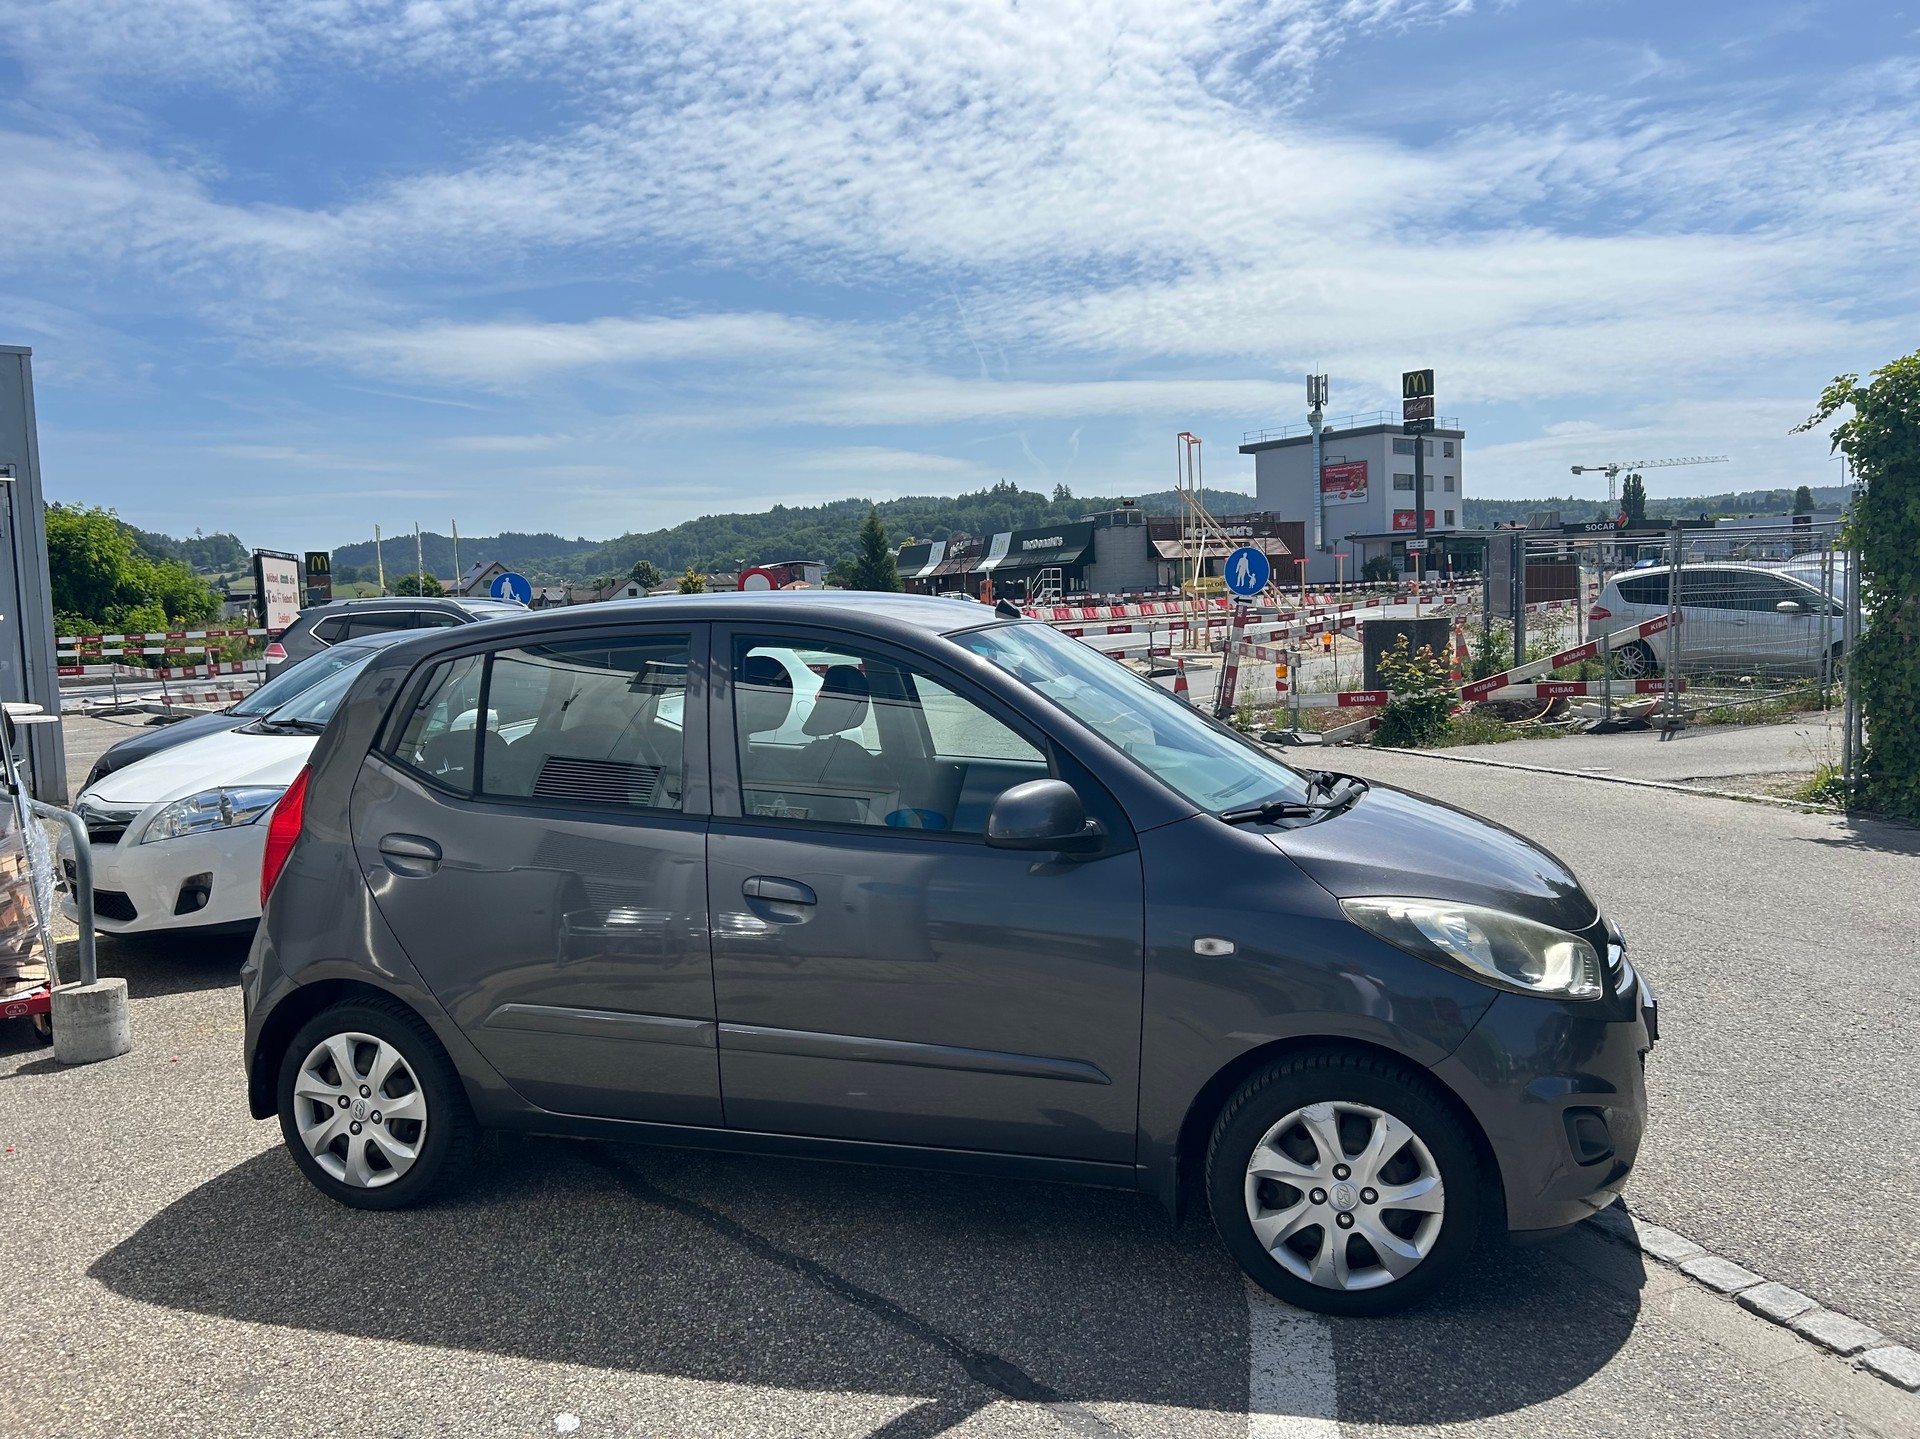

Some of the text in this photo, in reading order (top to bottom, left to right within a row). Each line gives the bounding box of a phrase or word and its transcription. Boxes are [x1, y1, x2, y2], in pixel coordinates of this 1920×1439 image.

[1185, 525, 1253, 537] McDonald's
[1585, 523, 1615, 532] SOCAR
[1022, 536, 1063, 550] McDonald's
[1650, 619, 1668, 631] KIBA
[1563, 649, 1586, 662] KIBAG
[1473, 680, 1497, 693] KIBAG
[1350, 695, 1376, 703] KIBAG
